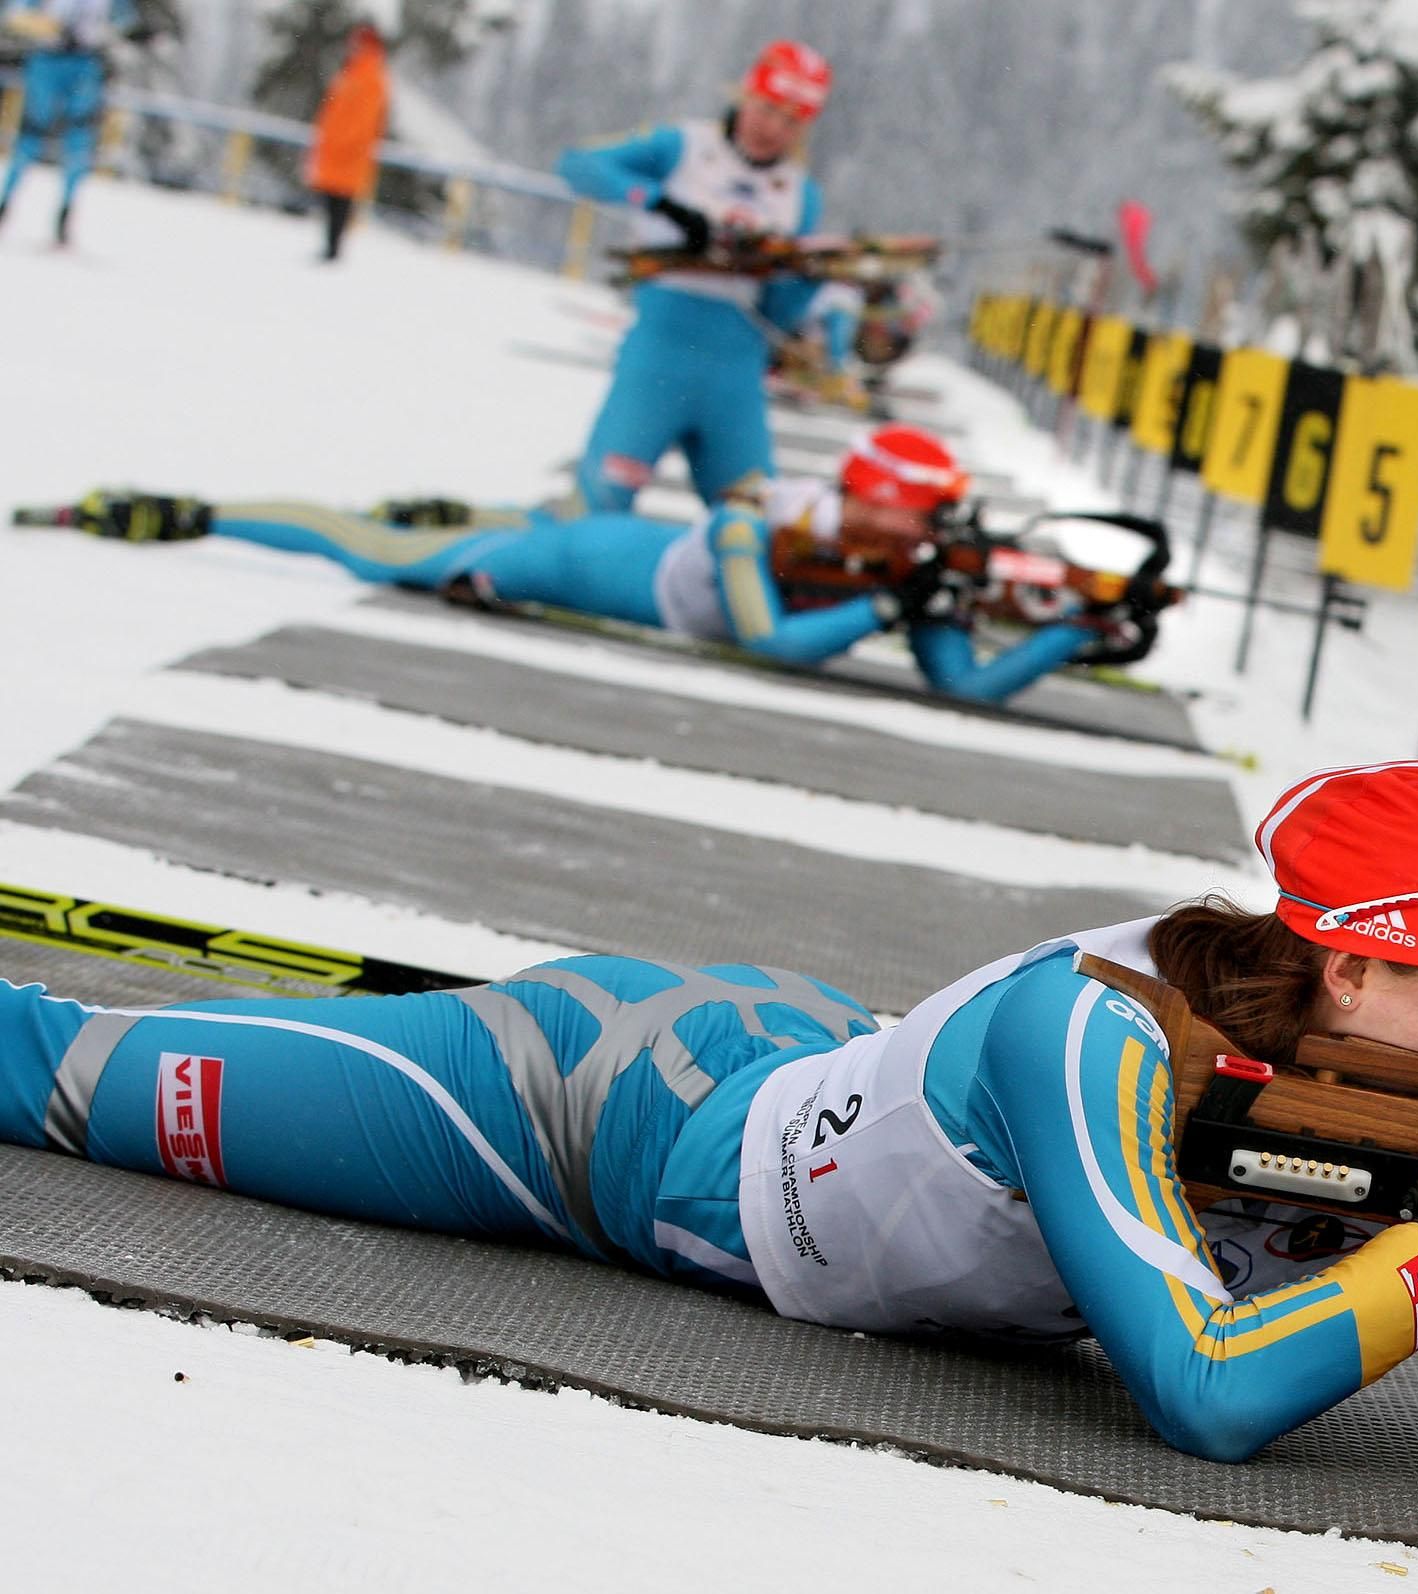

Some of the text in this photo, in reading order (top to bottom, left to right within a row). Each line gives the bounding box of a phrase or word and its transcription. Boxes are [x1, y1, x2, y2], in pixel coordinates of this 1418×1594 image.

[1229, 393, 1262, 469] 7
[1283, 412, 1332, 511] 6
[1360, 442, 1404, 544] 5
[781, 1118, 801, 1178] SUMMER
[811, 1093, 863, 1149] 2
[809, 1157, 838, 1183] 1
[781, 1183, 809, 1258] BIATHLON
[787, 1153, 828, 1267] CHAMPIONSHIP
